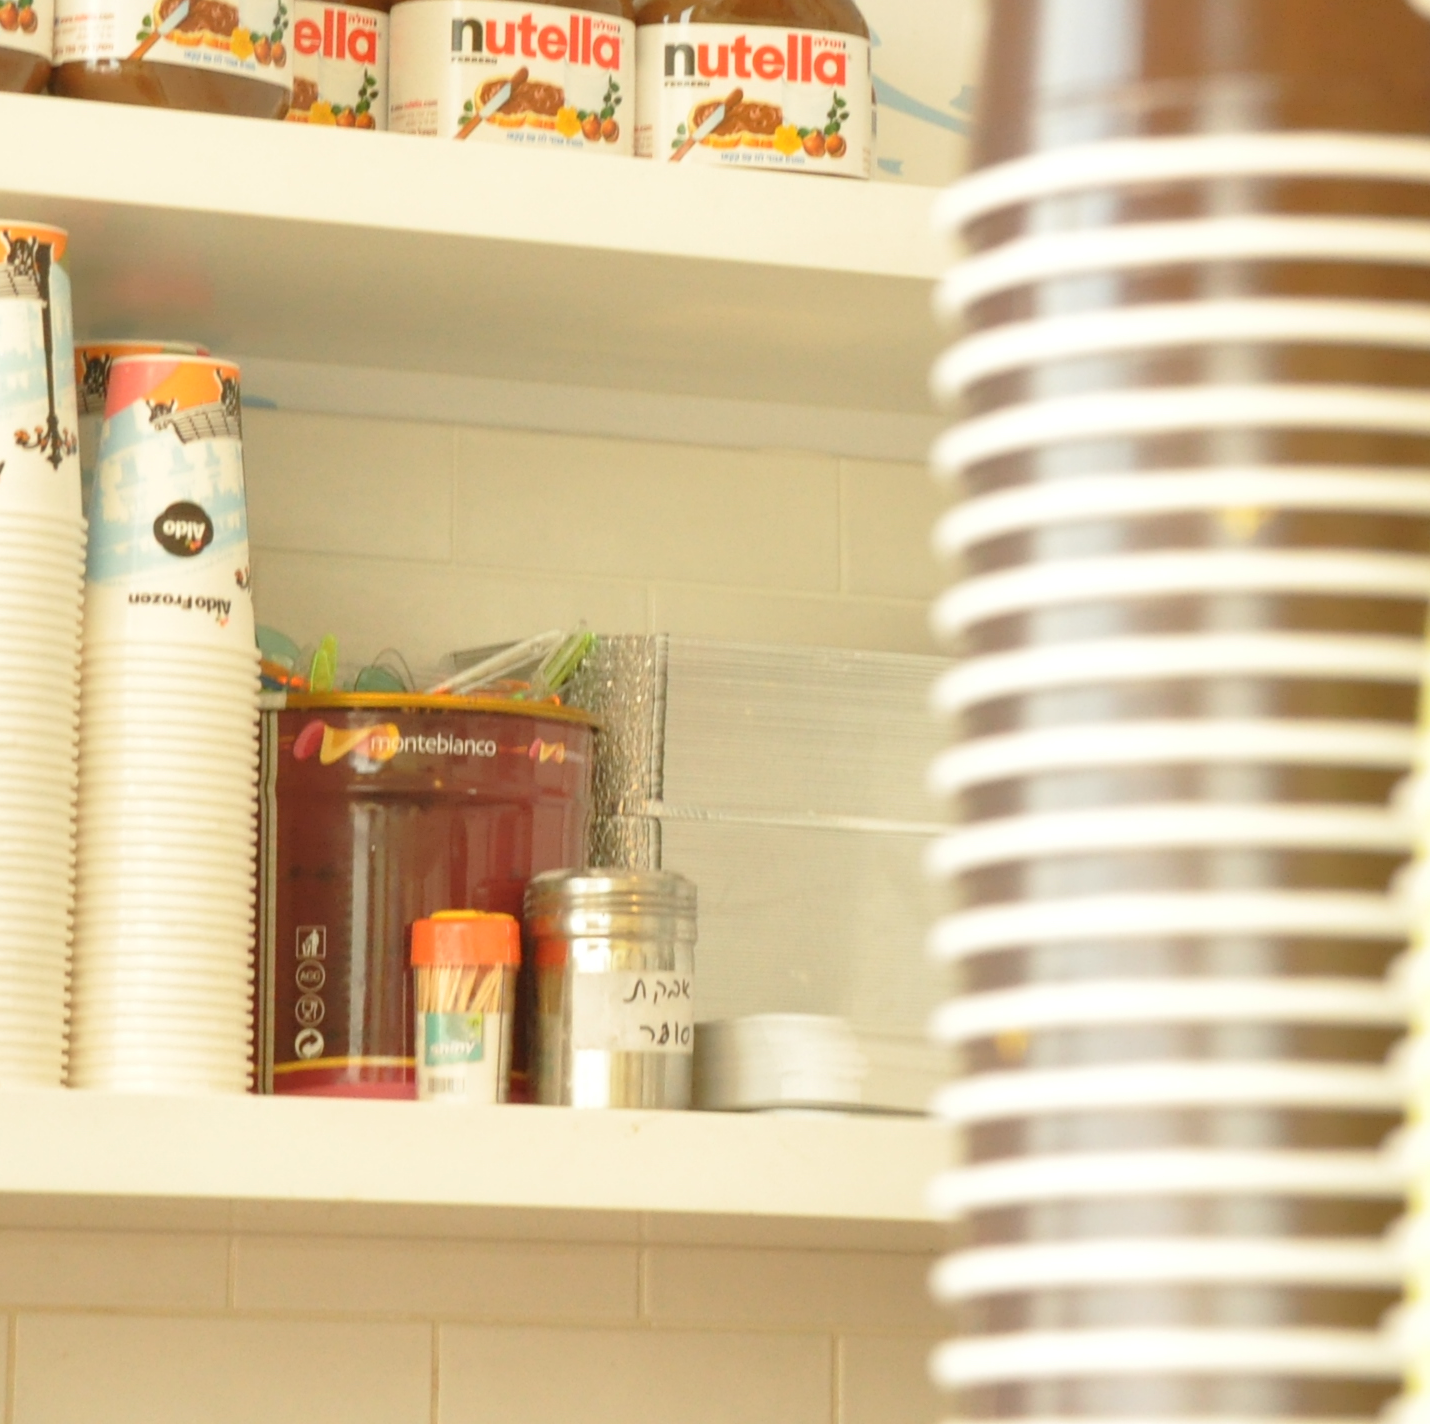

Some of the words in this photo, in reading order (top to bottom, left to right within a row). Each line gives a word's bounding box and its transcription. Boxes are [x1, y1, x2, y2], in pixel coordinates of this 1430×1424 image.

[293, 8, 378, 66] ella
[451, 13, 621, 71] nutella
[664, 33, 846, 87] nutella
[163, 520, 206, 540] Aldo
[128, 593, 192, 610] Frozen
[195, 596, 231, 616] Aldo
[370, 732, 498, 758] montebianco
[622, 978, 691, 1004] אבקת
